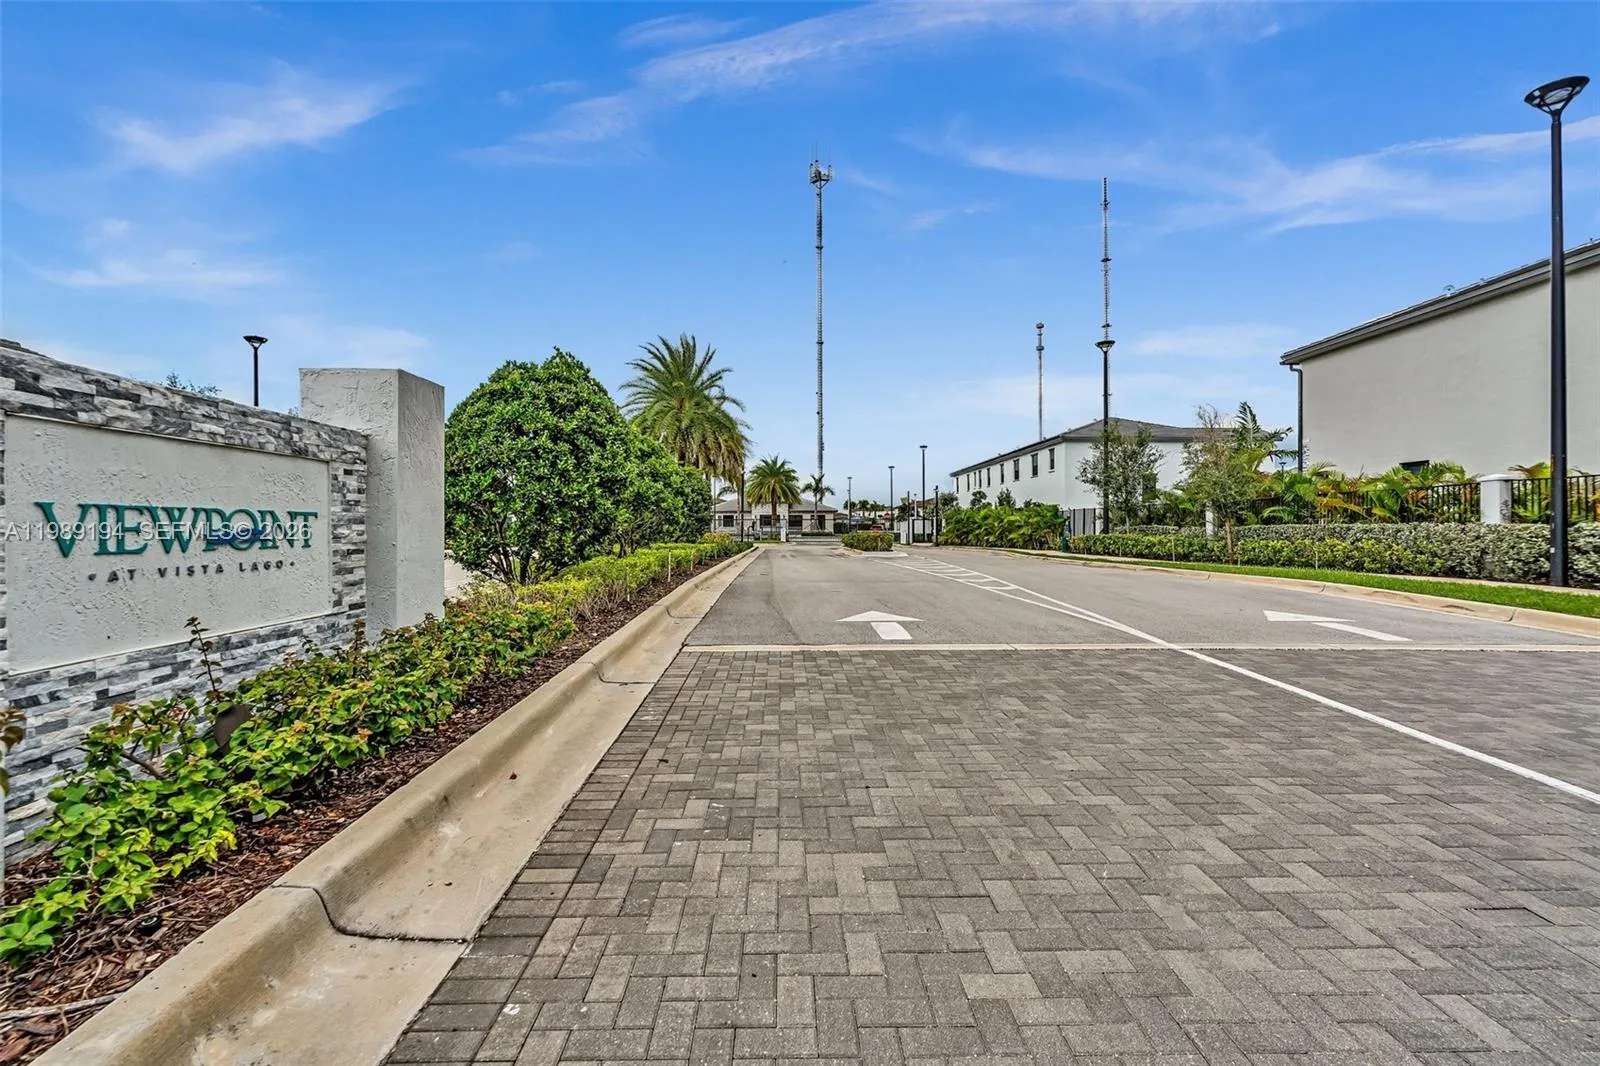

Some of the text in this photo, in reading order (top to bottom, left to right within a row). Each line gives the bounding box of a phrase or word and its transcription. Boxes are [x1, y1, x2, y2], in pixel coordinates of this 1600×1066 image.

[33, 501, 318, 558] VIEWPOINT
[107, 559, 284, 583] AT VISTA LAGO
